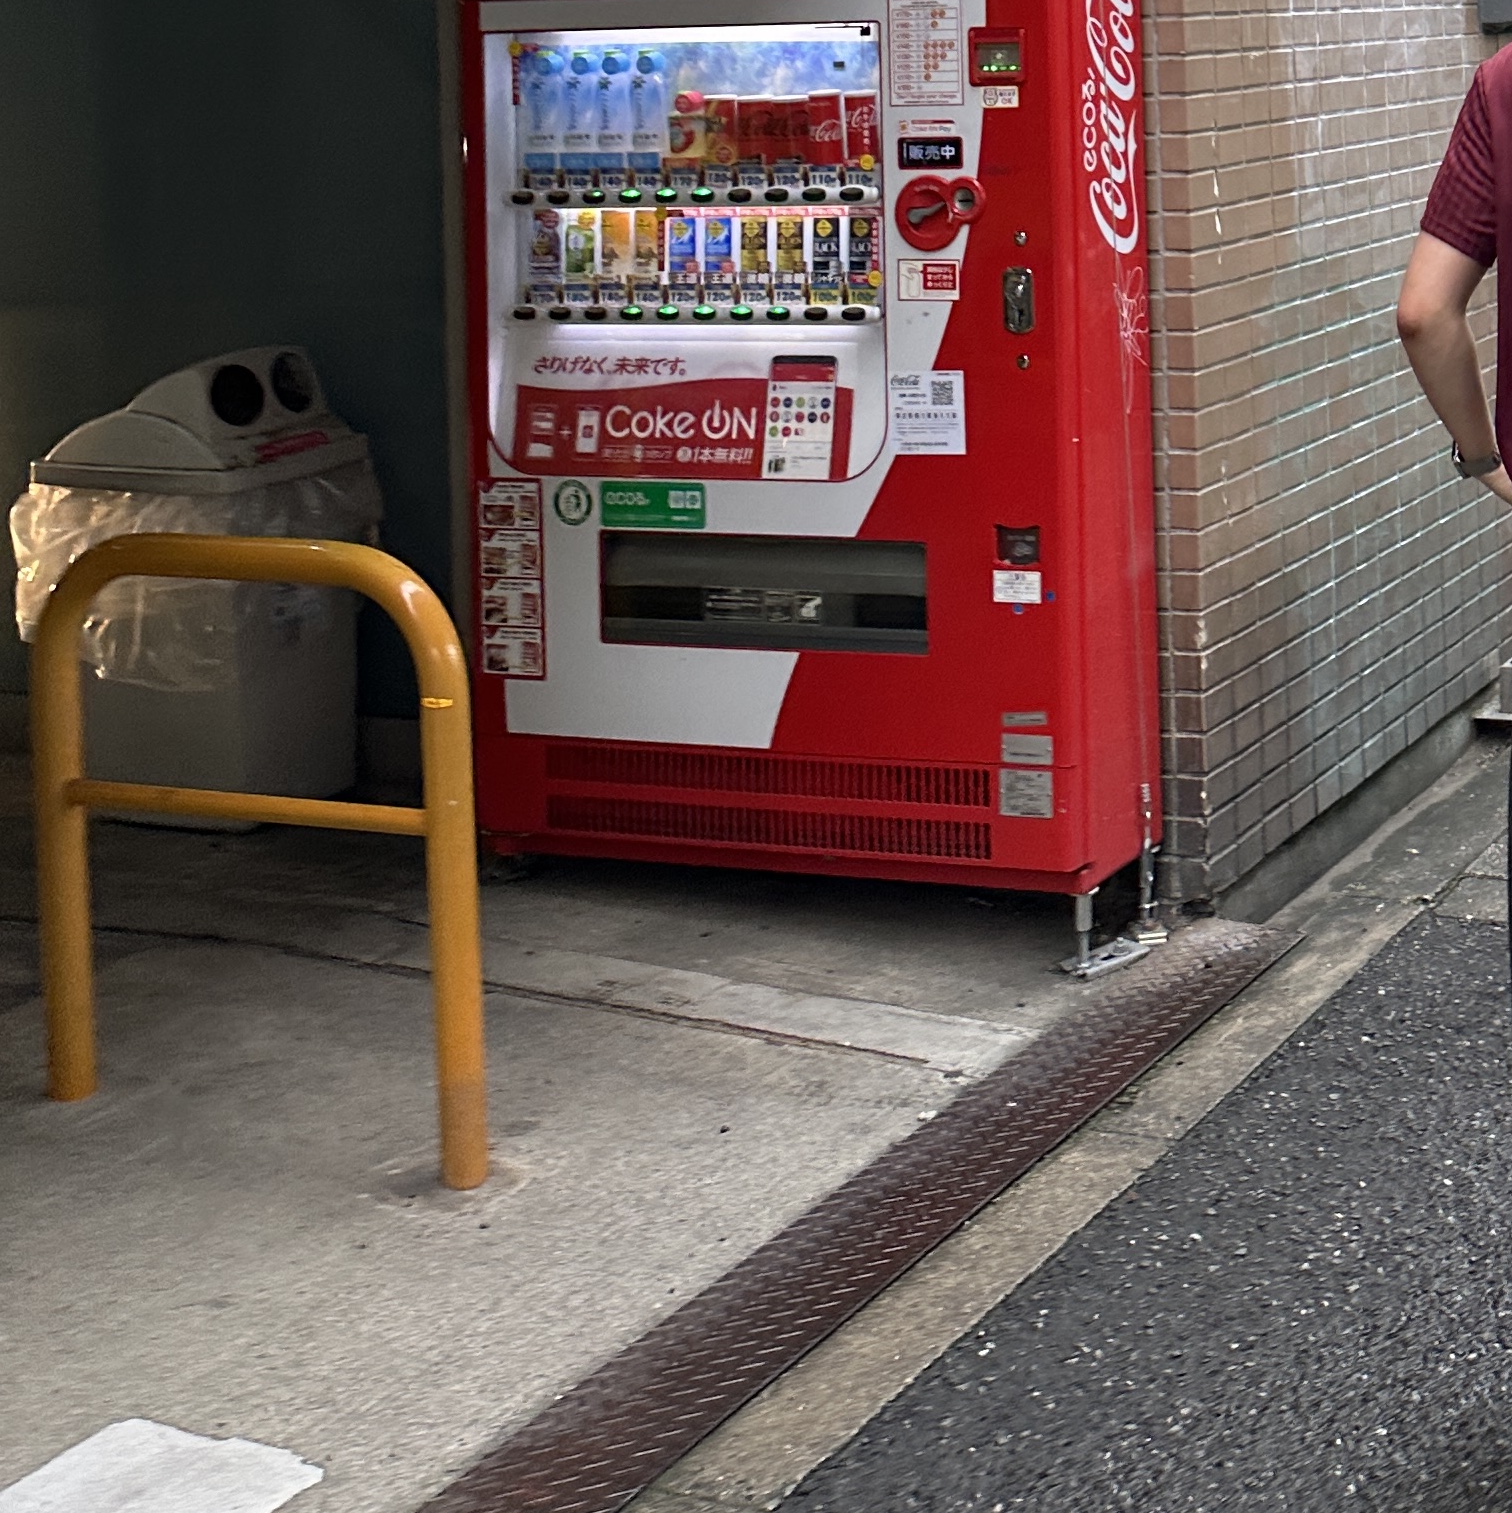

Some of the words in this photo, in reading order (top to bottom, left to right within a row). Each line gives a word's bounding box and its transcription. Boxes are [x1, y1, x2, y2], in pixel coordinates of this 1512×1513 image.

[533, 356, 687, 377] さりげなく、未来です。
[605, 404, 695, 439] Coke
[702, 400, 757, 439] ON
